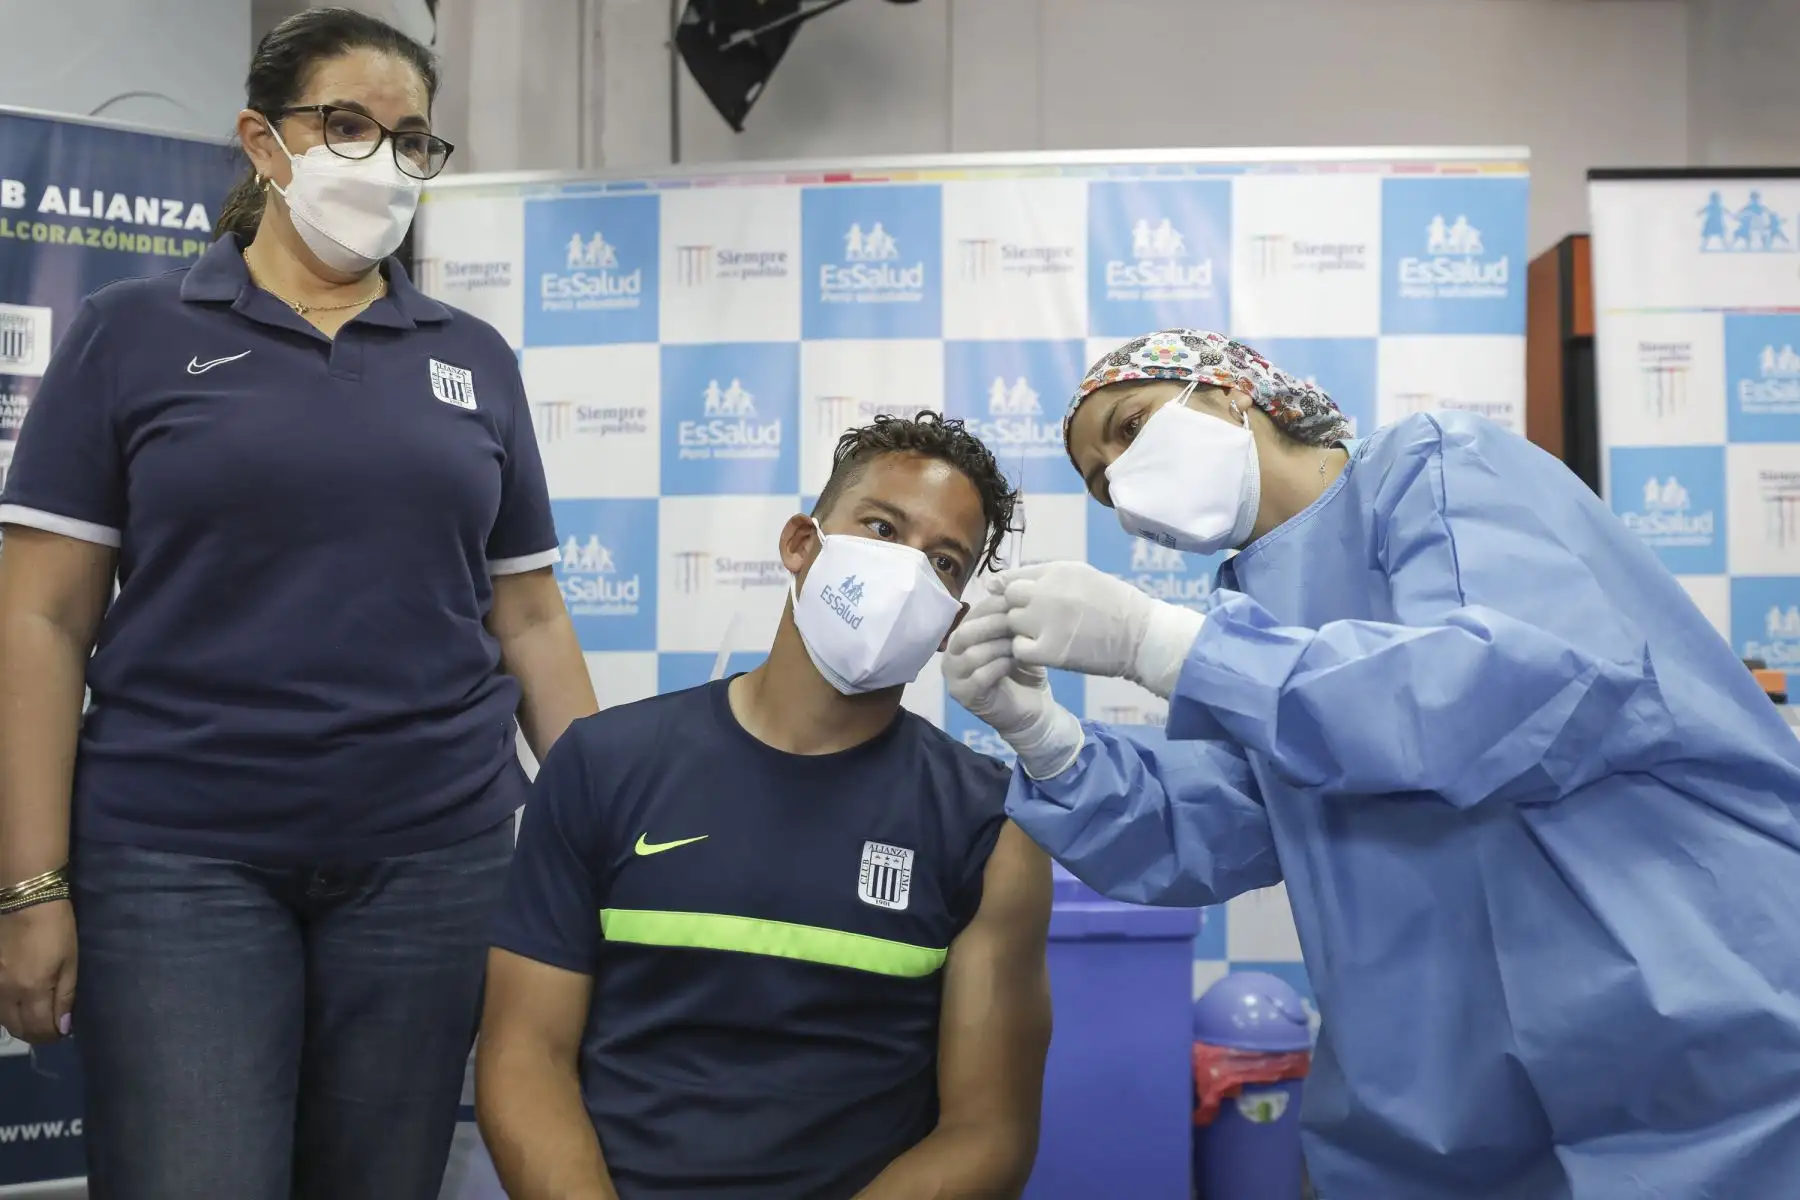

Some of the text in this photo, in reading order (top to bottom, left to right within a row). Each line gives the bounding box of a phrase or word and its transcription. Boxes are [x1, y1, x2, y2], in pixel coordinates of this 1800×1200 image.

[37, 185, 211, 233] ALIANZA
[717, 249, 788, 266] Siempre
[1001, 244, 1075, 263] Siempre
[1292, 241, 1366, 261] Siempre
[444, 260, 512, 277] Siempre
[820, 260, 924, 289] EsSalud
[1106, 258, 1212, 287] EsSalud
[1399, 255, 1508, 285] EsSalud
[540, 267, 641, 299] EsSalud
[435, 362, 467, 376] ALIANZA
[577, 405, 647, 422] Siempre
[679, 417, 781, 447] EsSalud
[1623, 509, 1714, 534] EsSalud
[820, 584, 864, 630] EsSalud
[868, 843, 908, 858] ALIANZA
[860, 859, 869, 885] CLUB
[901, 867, 910, 893] LIMA
